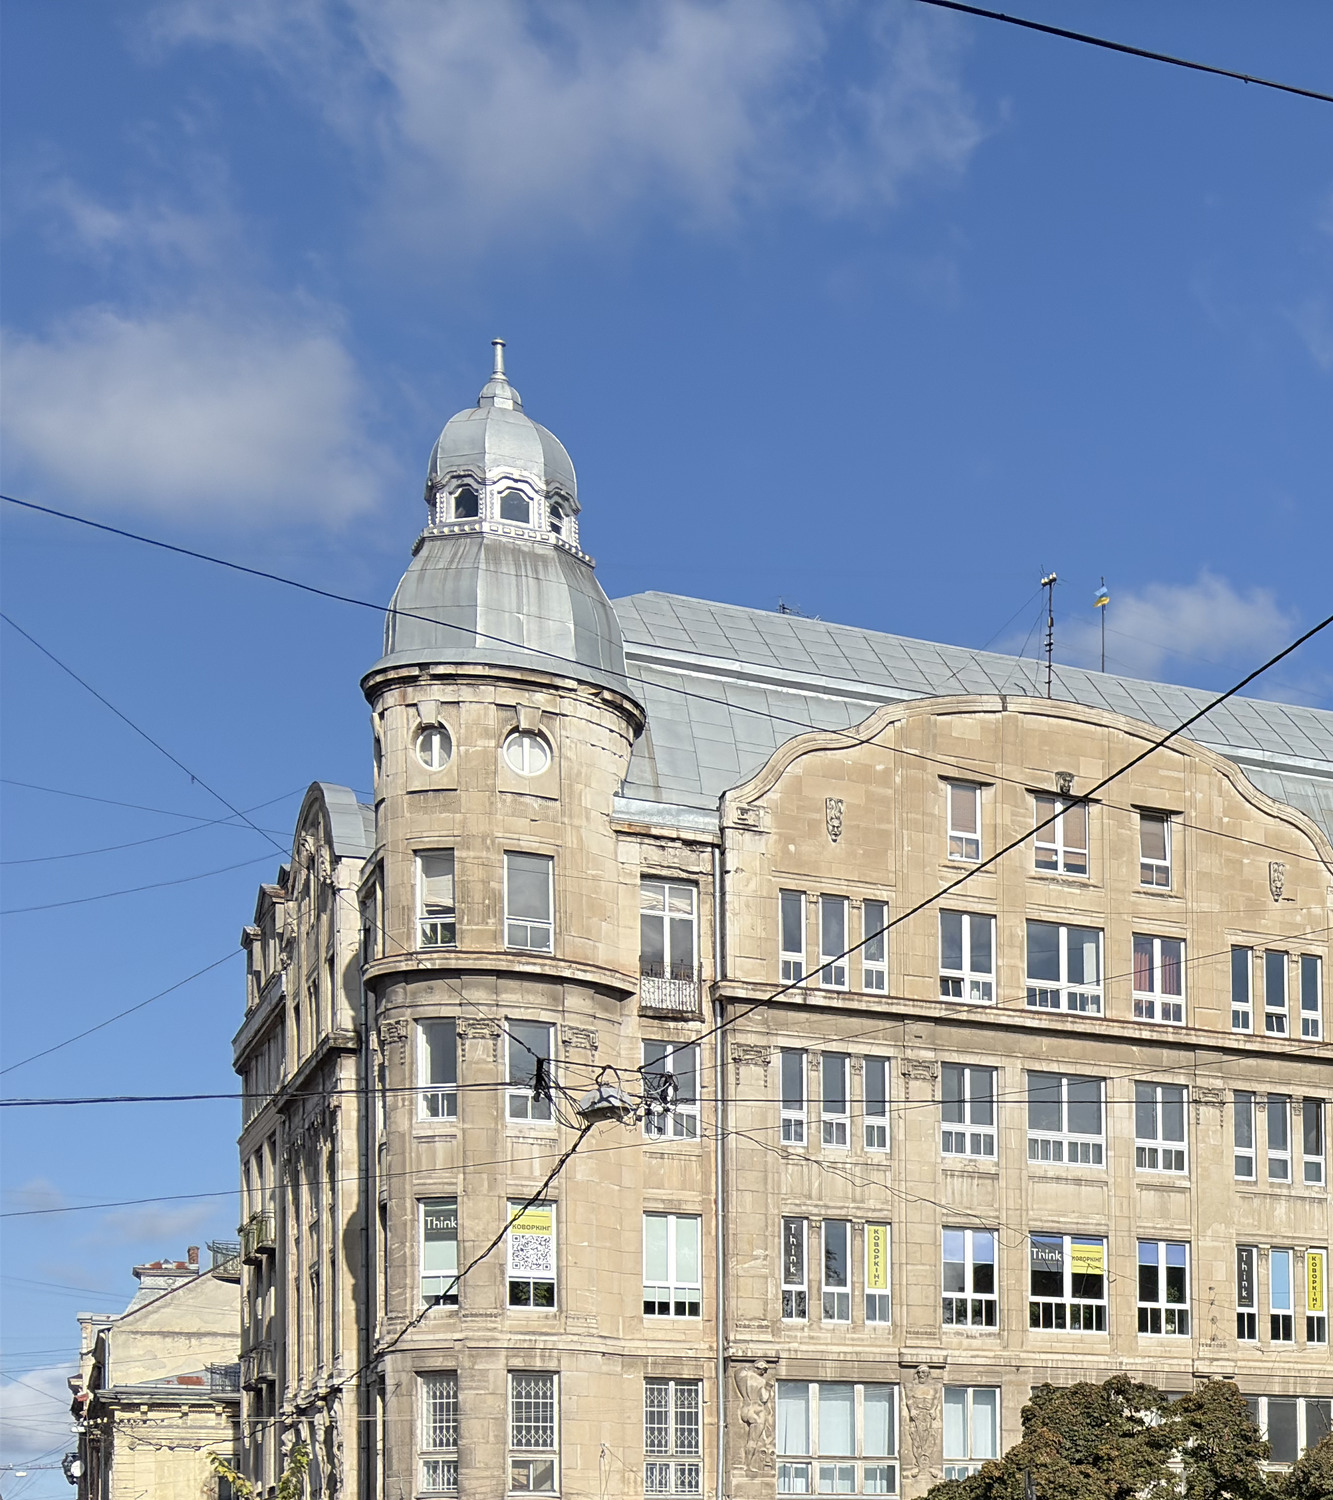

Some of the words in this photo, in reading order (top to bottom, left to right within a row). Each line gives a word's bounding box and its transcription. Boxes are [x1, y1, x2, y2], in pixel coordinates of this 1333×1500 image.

[425, 1216, 457, 1229] Think
[511, 1223, 551, 1232] КОВОРКІНГ
[789, 1224, 797, 1274] Think
[1031, 1248, 1062, 1261] Think
